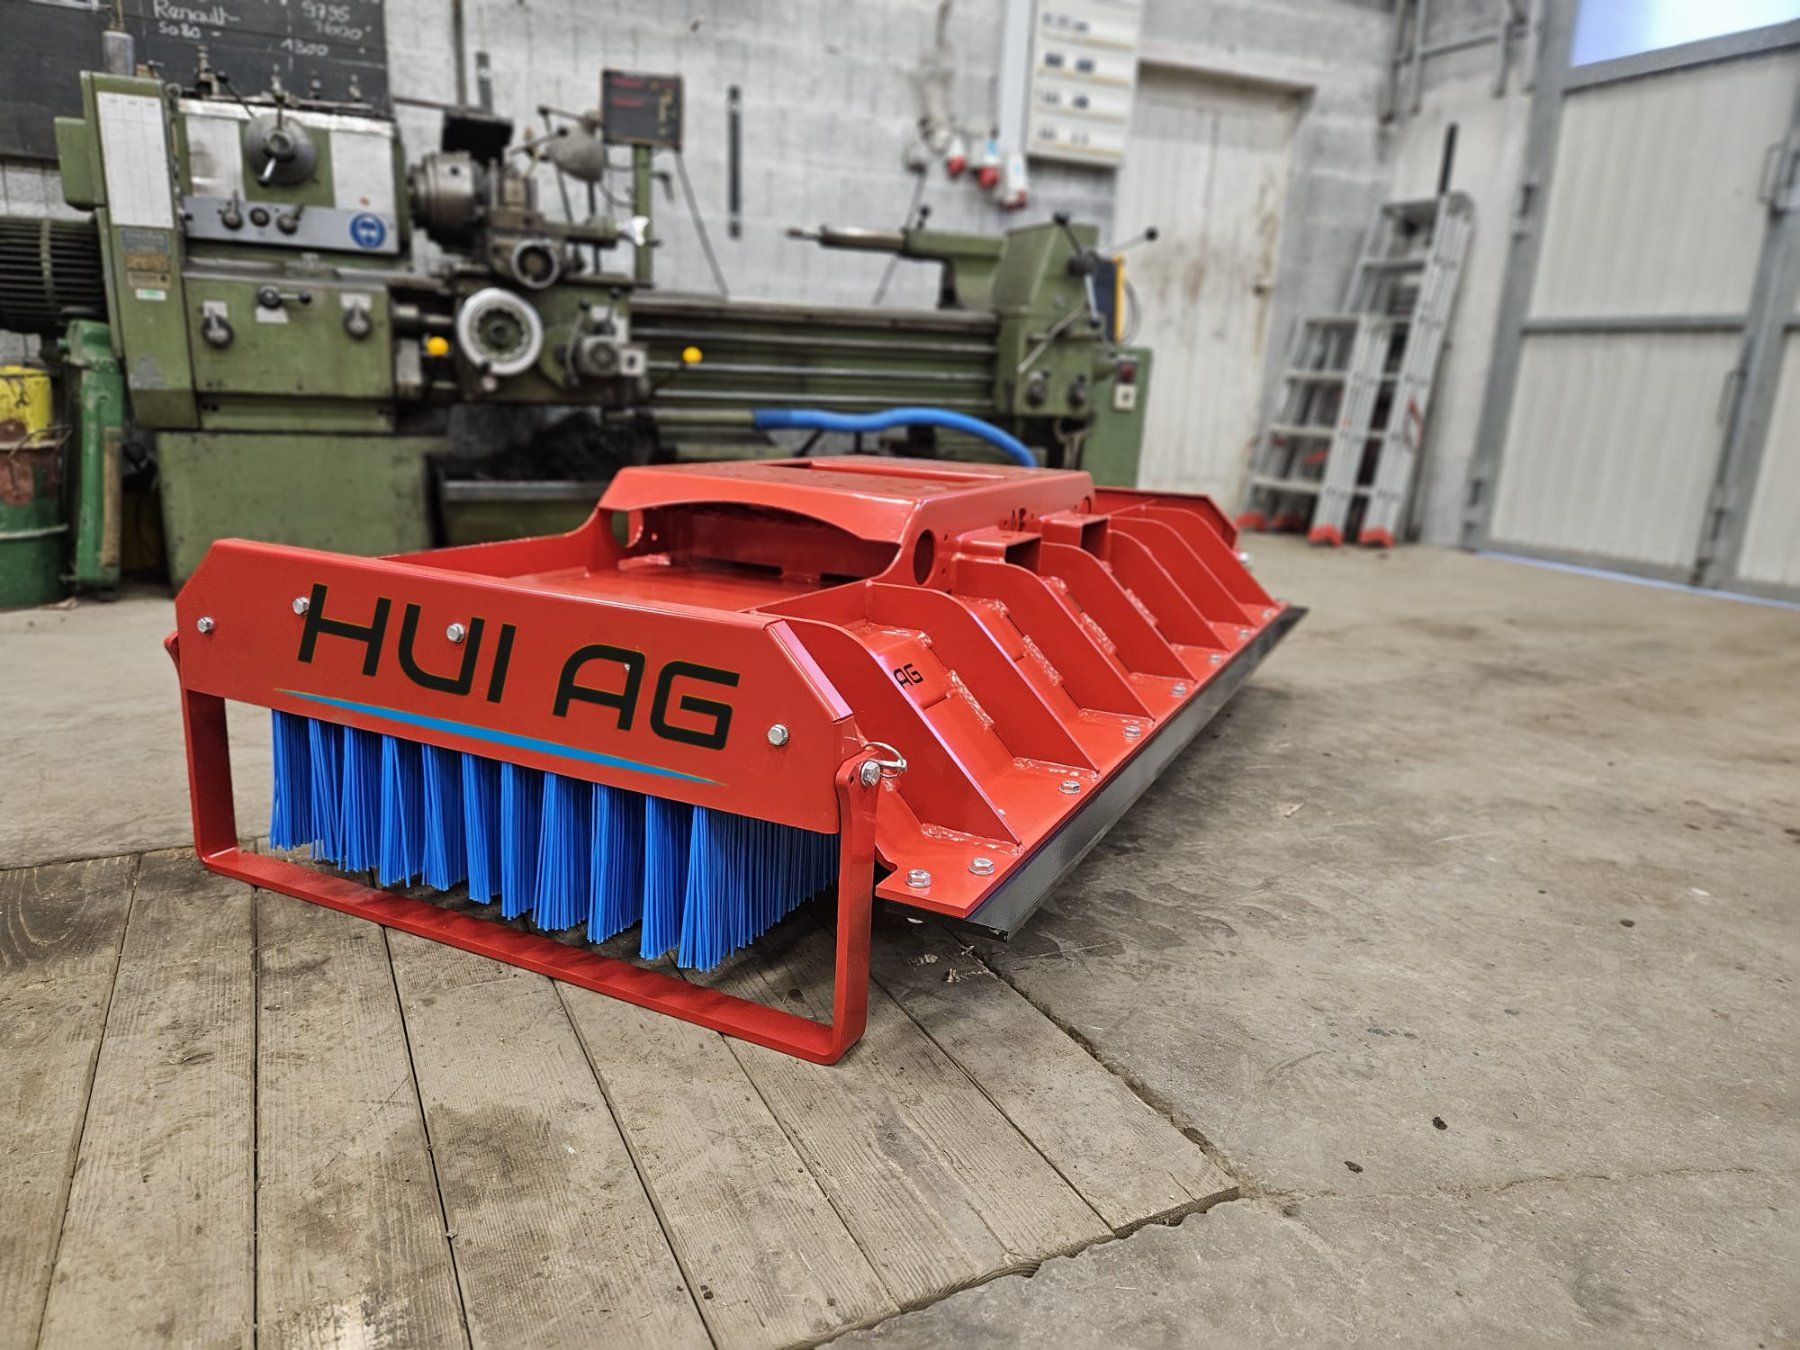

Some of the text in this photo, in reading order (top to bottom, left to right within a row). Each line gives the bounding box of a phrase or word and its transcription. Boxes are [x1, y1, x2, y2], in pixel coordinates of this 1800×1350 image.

[297, 583, 740, 751] HUI AG
[893, 662, 924, 690] AG
